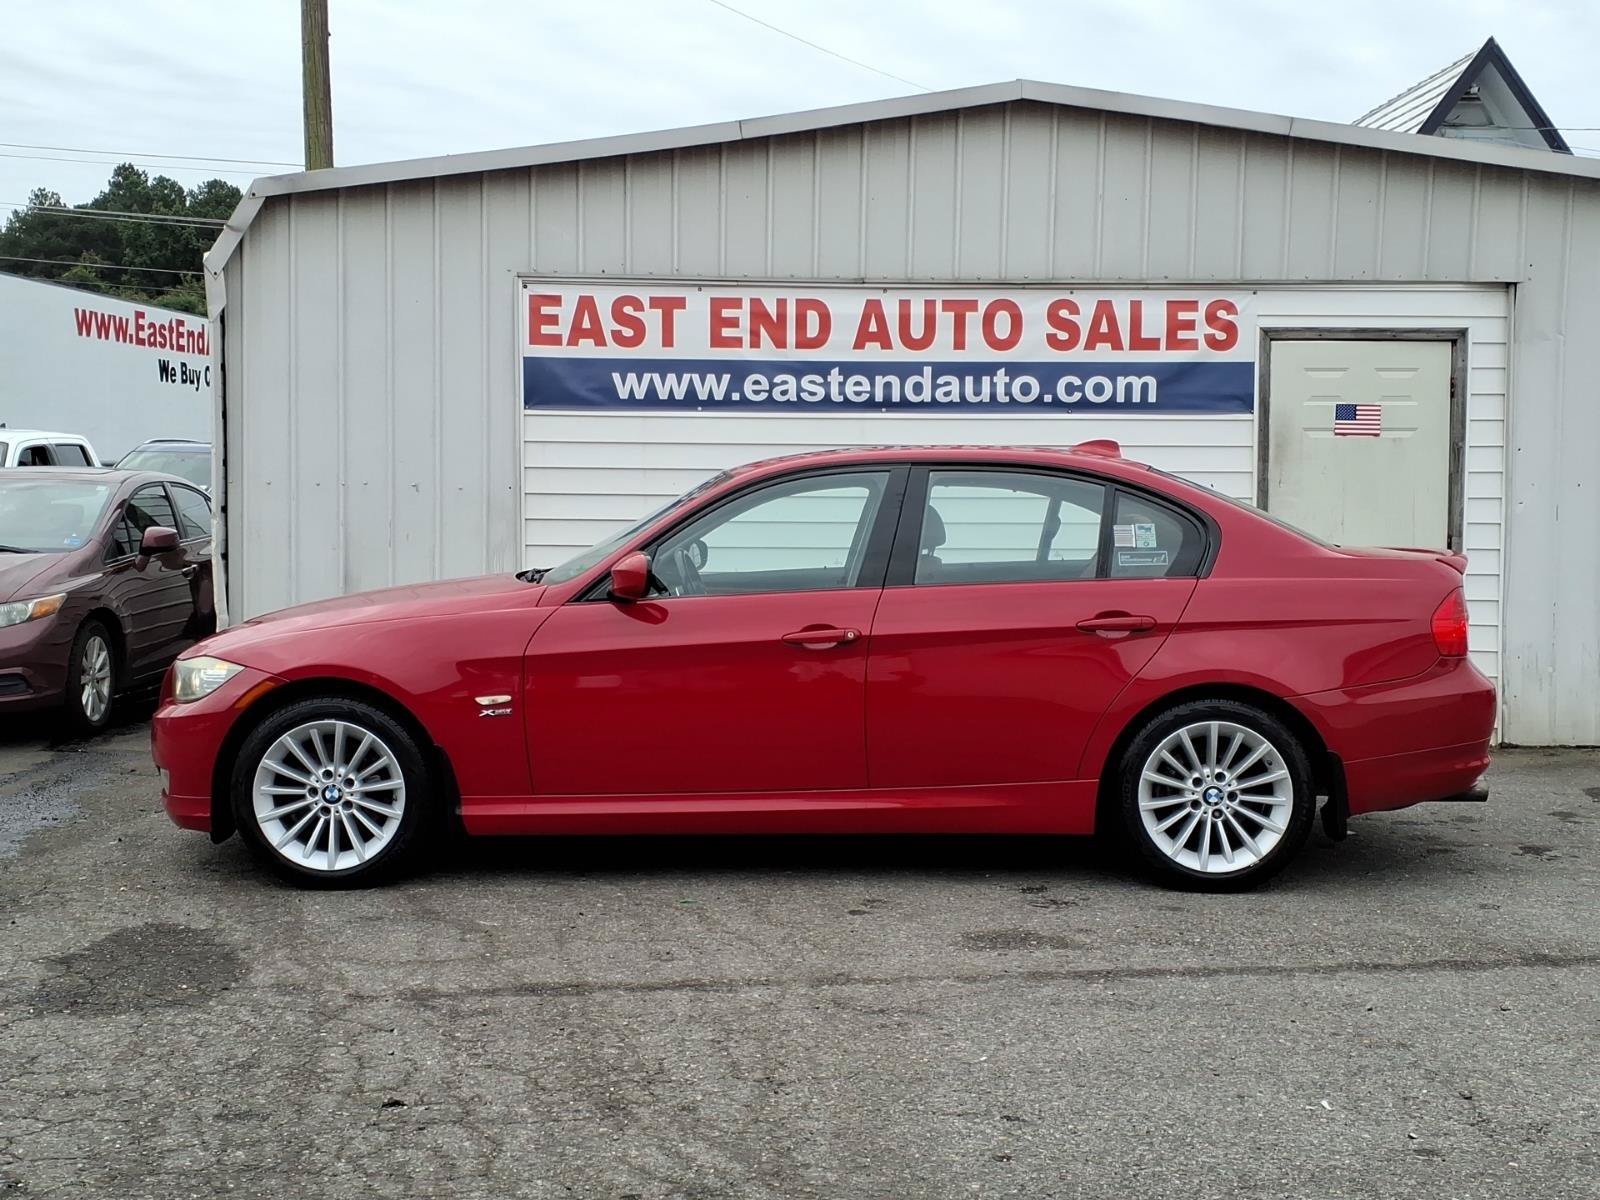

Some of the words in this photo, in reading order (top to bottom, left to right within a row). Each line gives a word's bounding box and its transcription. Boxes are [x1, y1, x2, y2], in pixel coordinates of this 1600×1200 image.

[528, 294, 687, 348] EAST
[709, 297, 832, 350] END
[852, 298, 1024, 352] AUTO
[1045, 298, 1239, 352] SALES
[158, 358, 177, 384] We
[180, 361, 201, 392] Buy
[611, 365, 1158, 403] www.eastendauto.com
